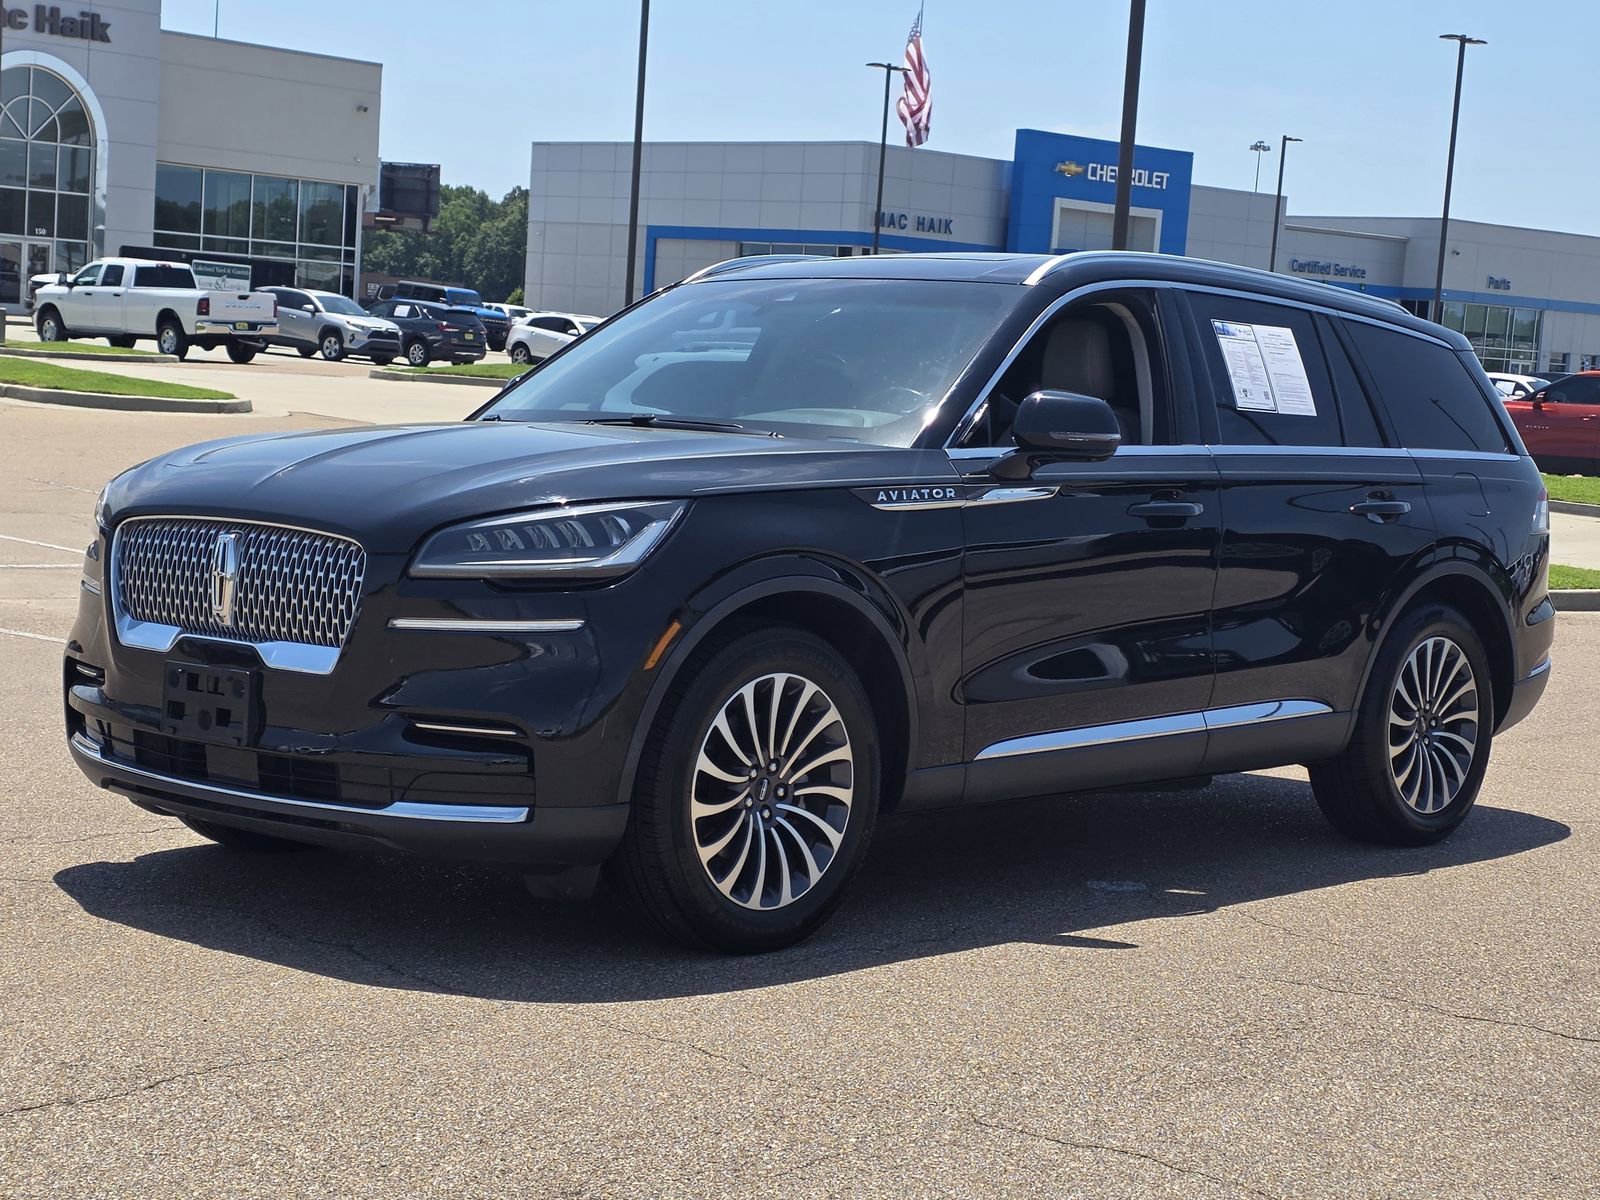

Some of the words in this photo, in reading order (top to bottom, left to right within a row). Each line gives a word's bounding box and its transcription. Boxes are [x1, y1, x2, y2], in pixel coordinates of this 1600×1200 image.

[34, 4, 113, 43] Haik
[1087, 162, 1170, 190] CHEOLET
[916, 215, 953, 235] HAIK
[1291, 259, 1332, 276] Certified
[1334, 263, 1367, 279] Service
[1488, 276, 1511, 291] Parts
[877, 487, 956, 502] AVIATOR
